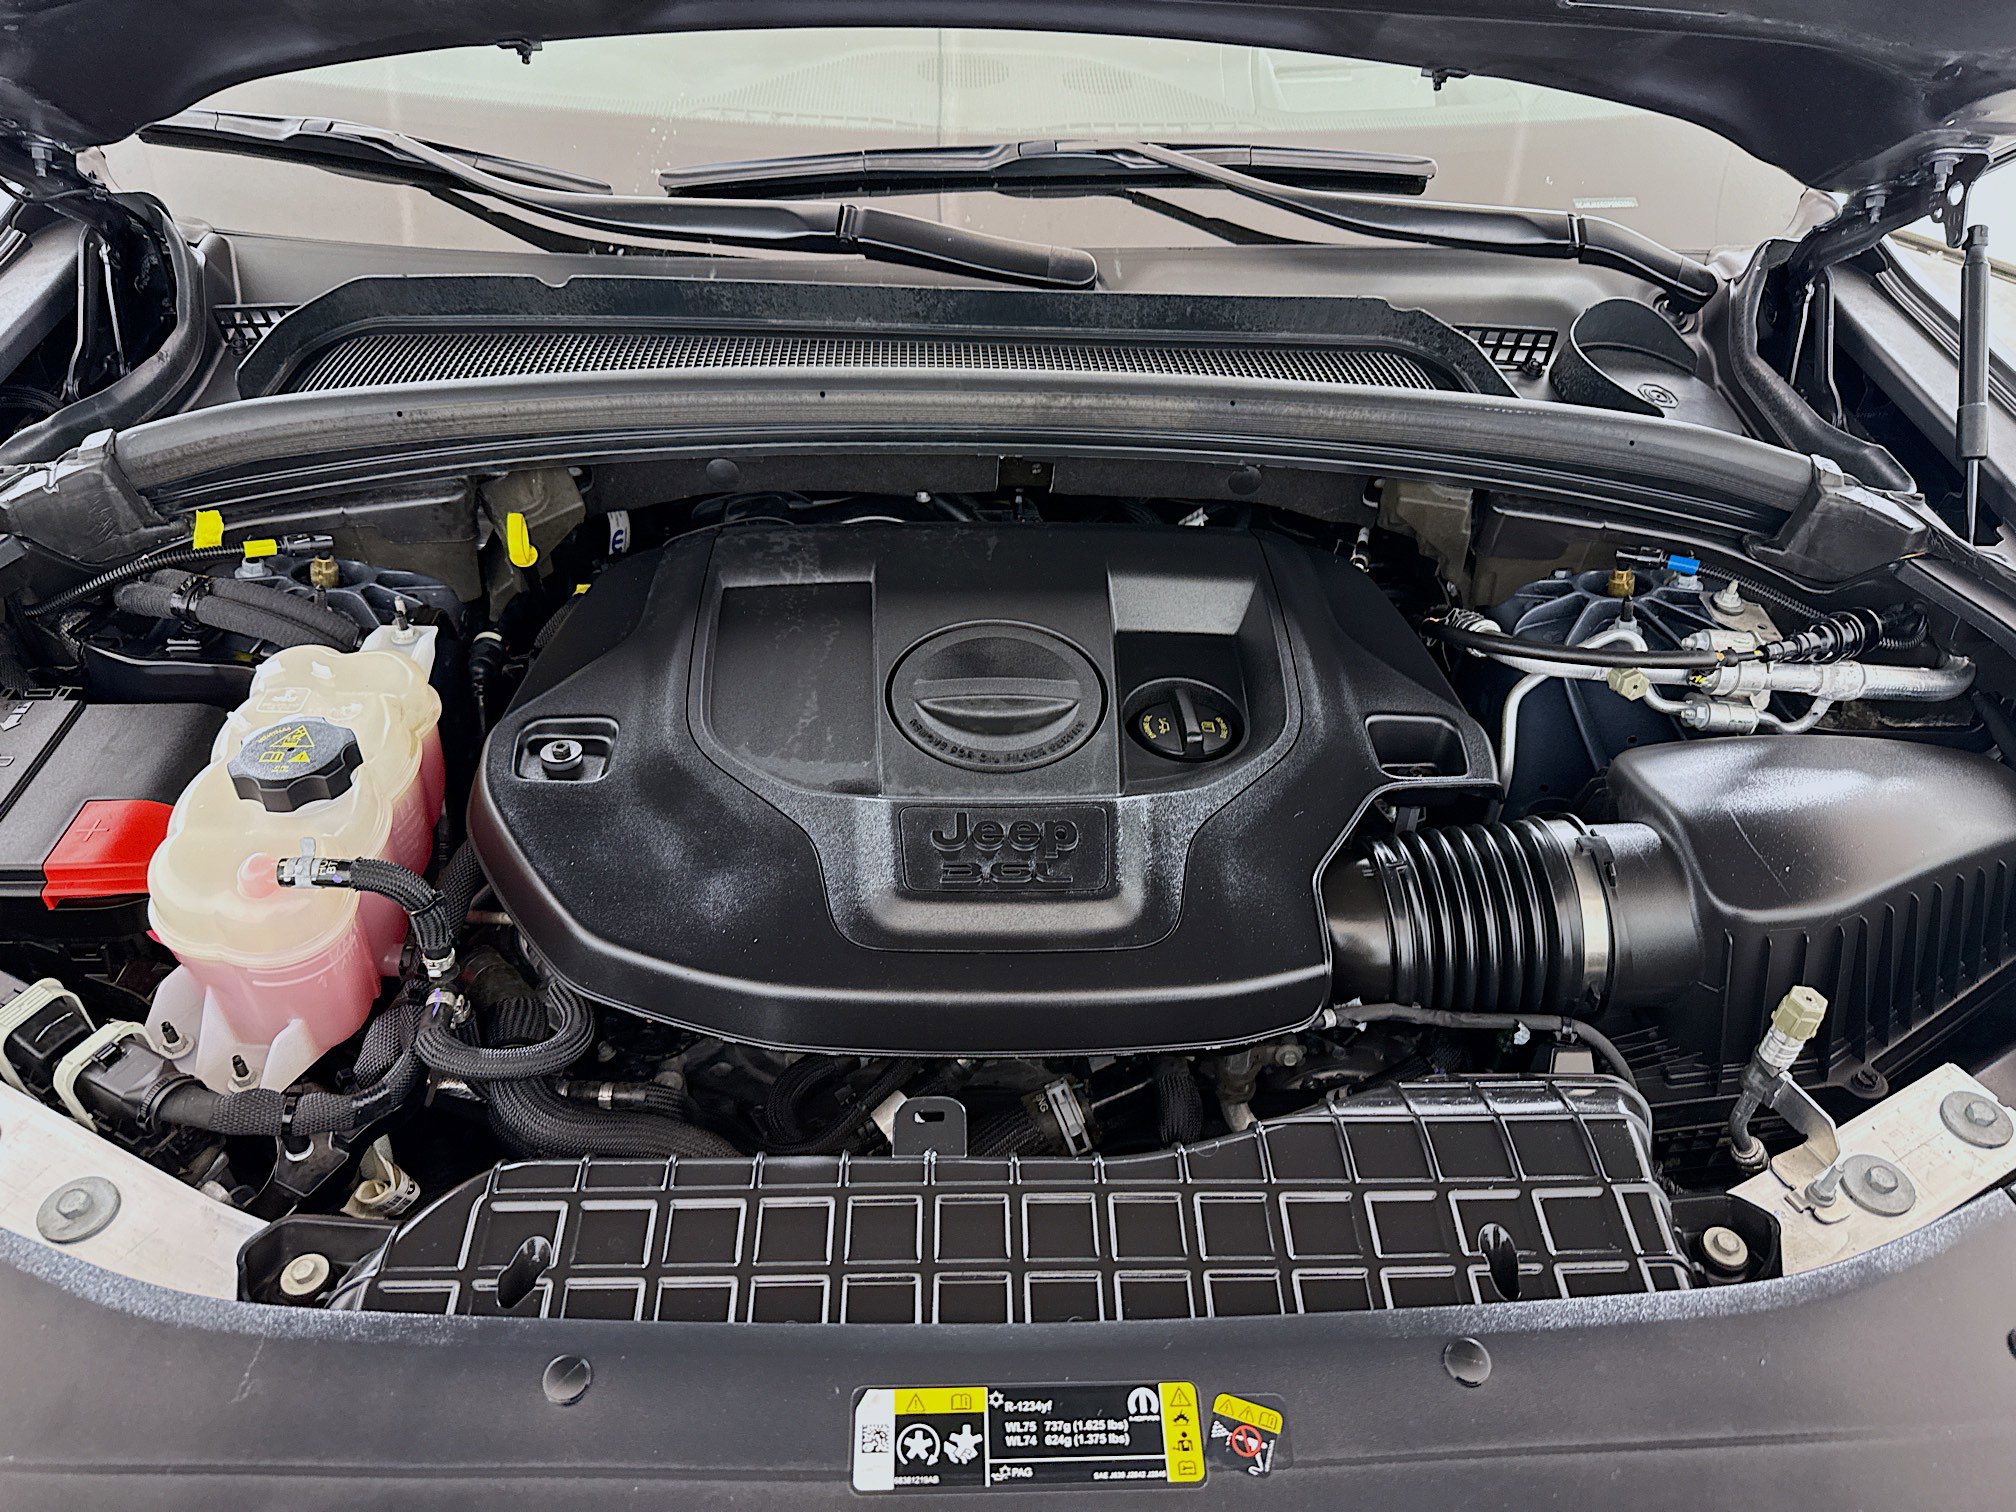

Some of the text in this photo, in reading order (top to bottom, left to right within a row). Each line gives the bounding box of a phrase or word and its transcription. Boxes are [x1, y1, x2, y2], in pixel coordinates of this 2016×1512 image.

[931, 812, 1079, 858] Jeep
[940, 861, 1074, 884] 3.6L
[1004, 1399, 1053, 1414] R-1234yf
[1004, 1421, 1038, 1433] WL75
[1044, 1420, 1072, 1433] 737g
[1107, 1418, 1129, 1432] lbs)
[1005, 1432, 1131, 1448] WL74 624g (1.375 lbs)
[1011, 1466, 1034, 1479] PAG
